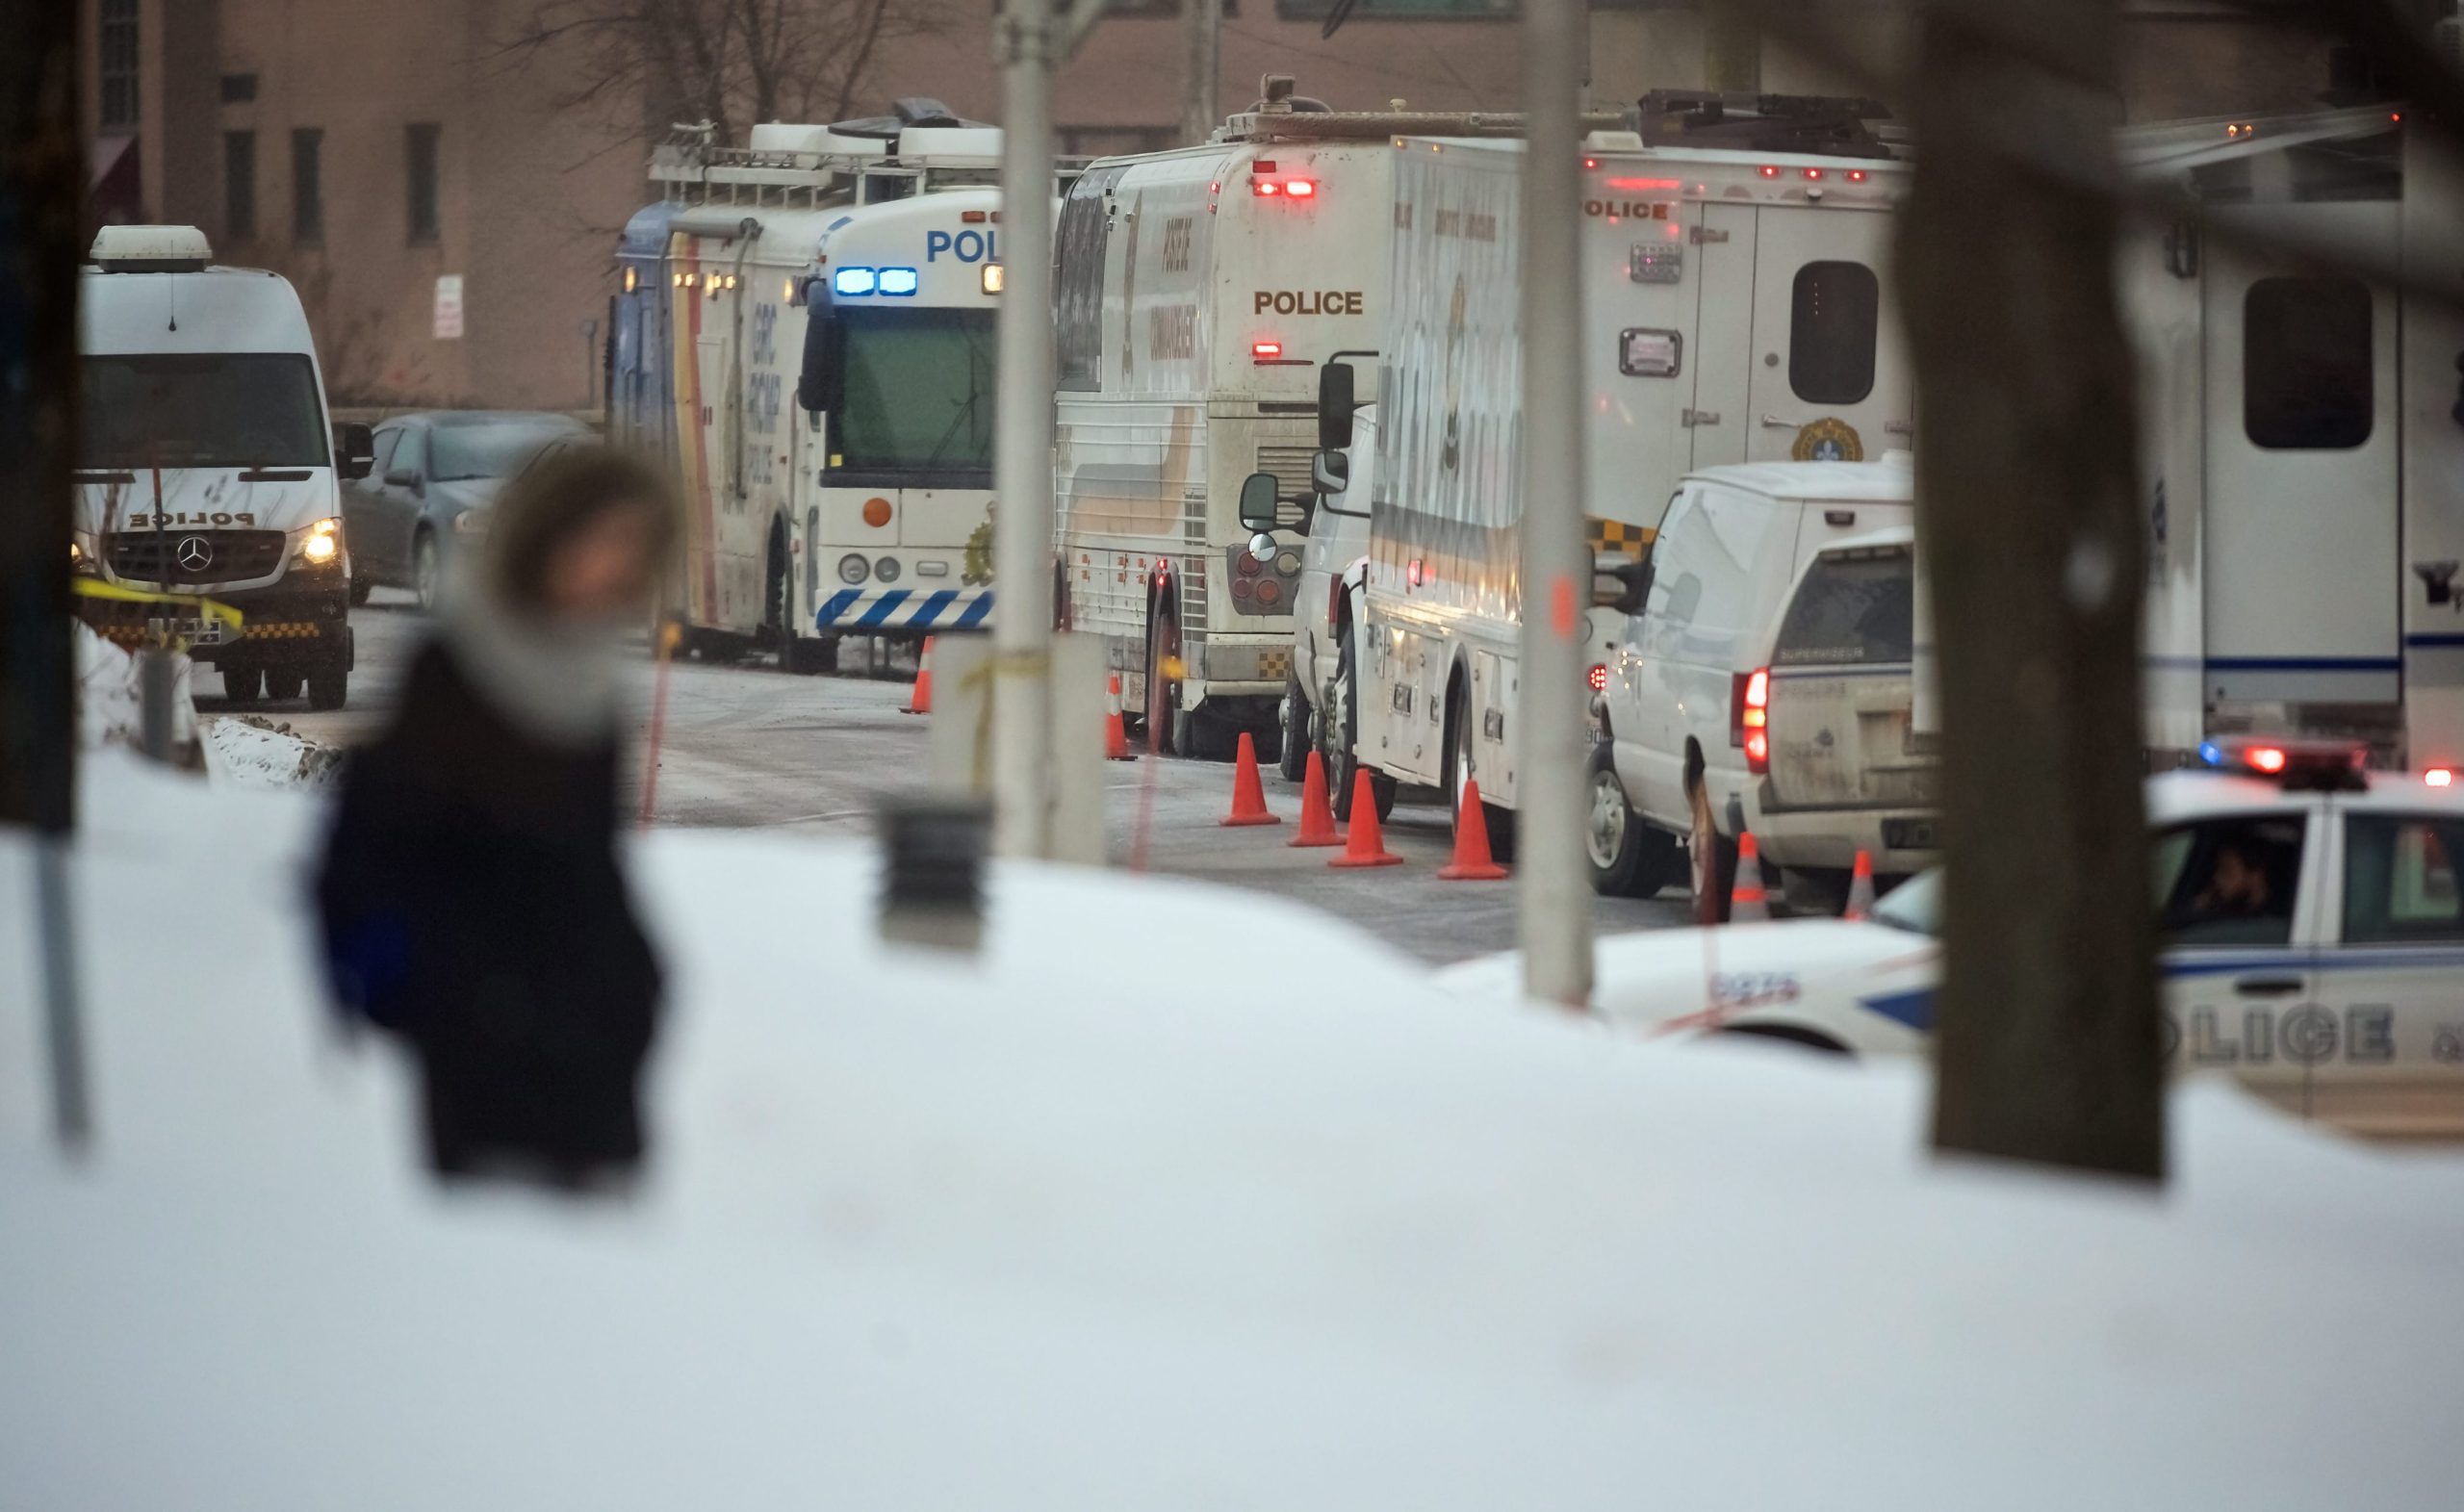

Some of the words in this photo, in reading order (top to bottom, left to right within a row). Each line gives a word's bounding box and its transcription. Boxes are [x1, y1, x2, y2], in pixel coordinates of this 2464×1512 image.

[1579, 199, 1668, 219] OLICE
[927, 230, 1002, 263] POL
[1254, 291, 1363, 315] POLICE
[2165, 1003, 2395, 1064] LICE
